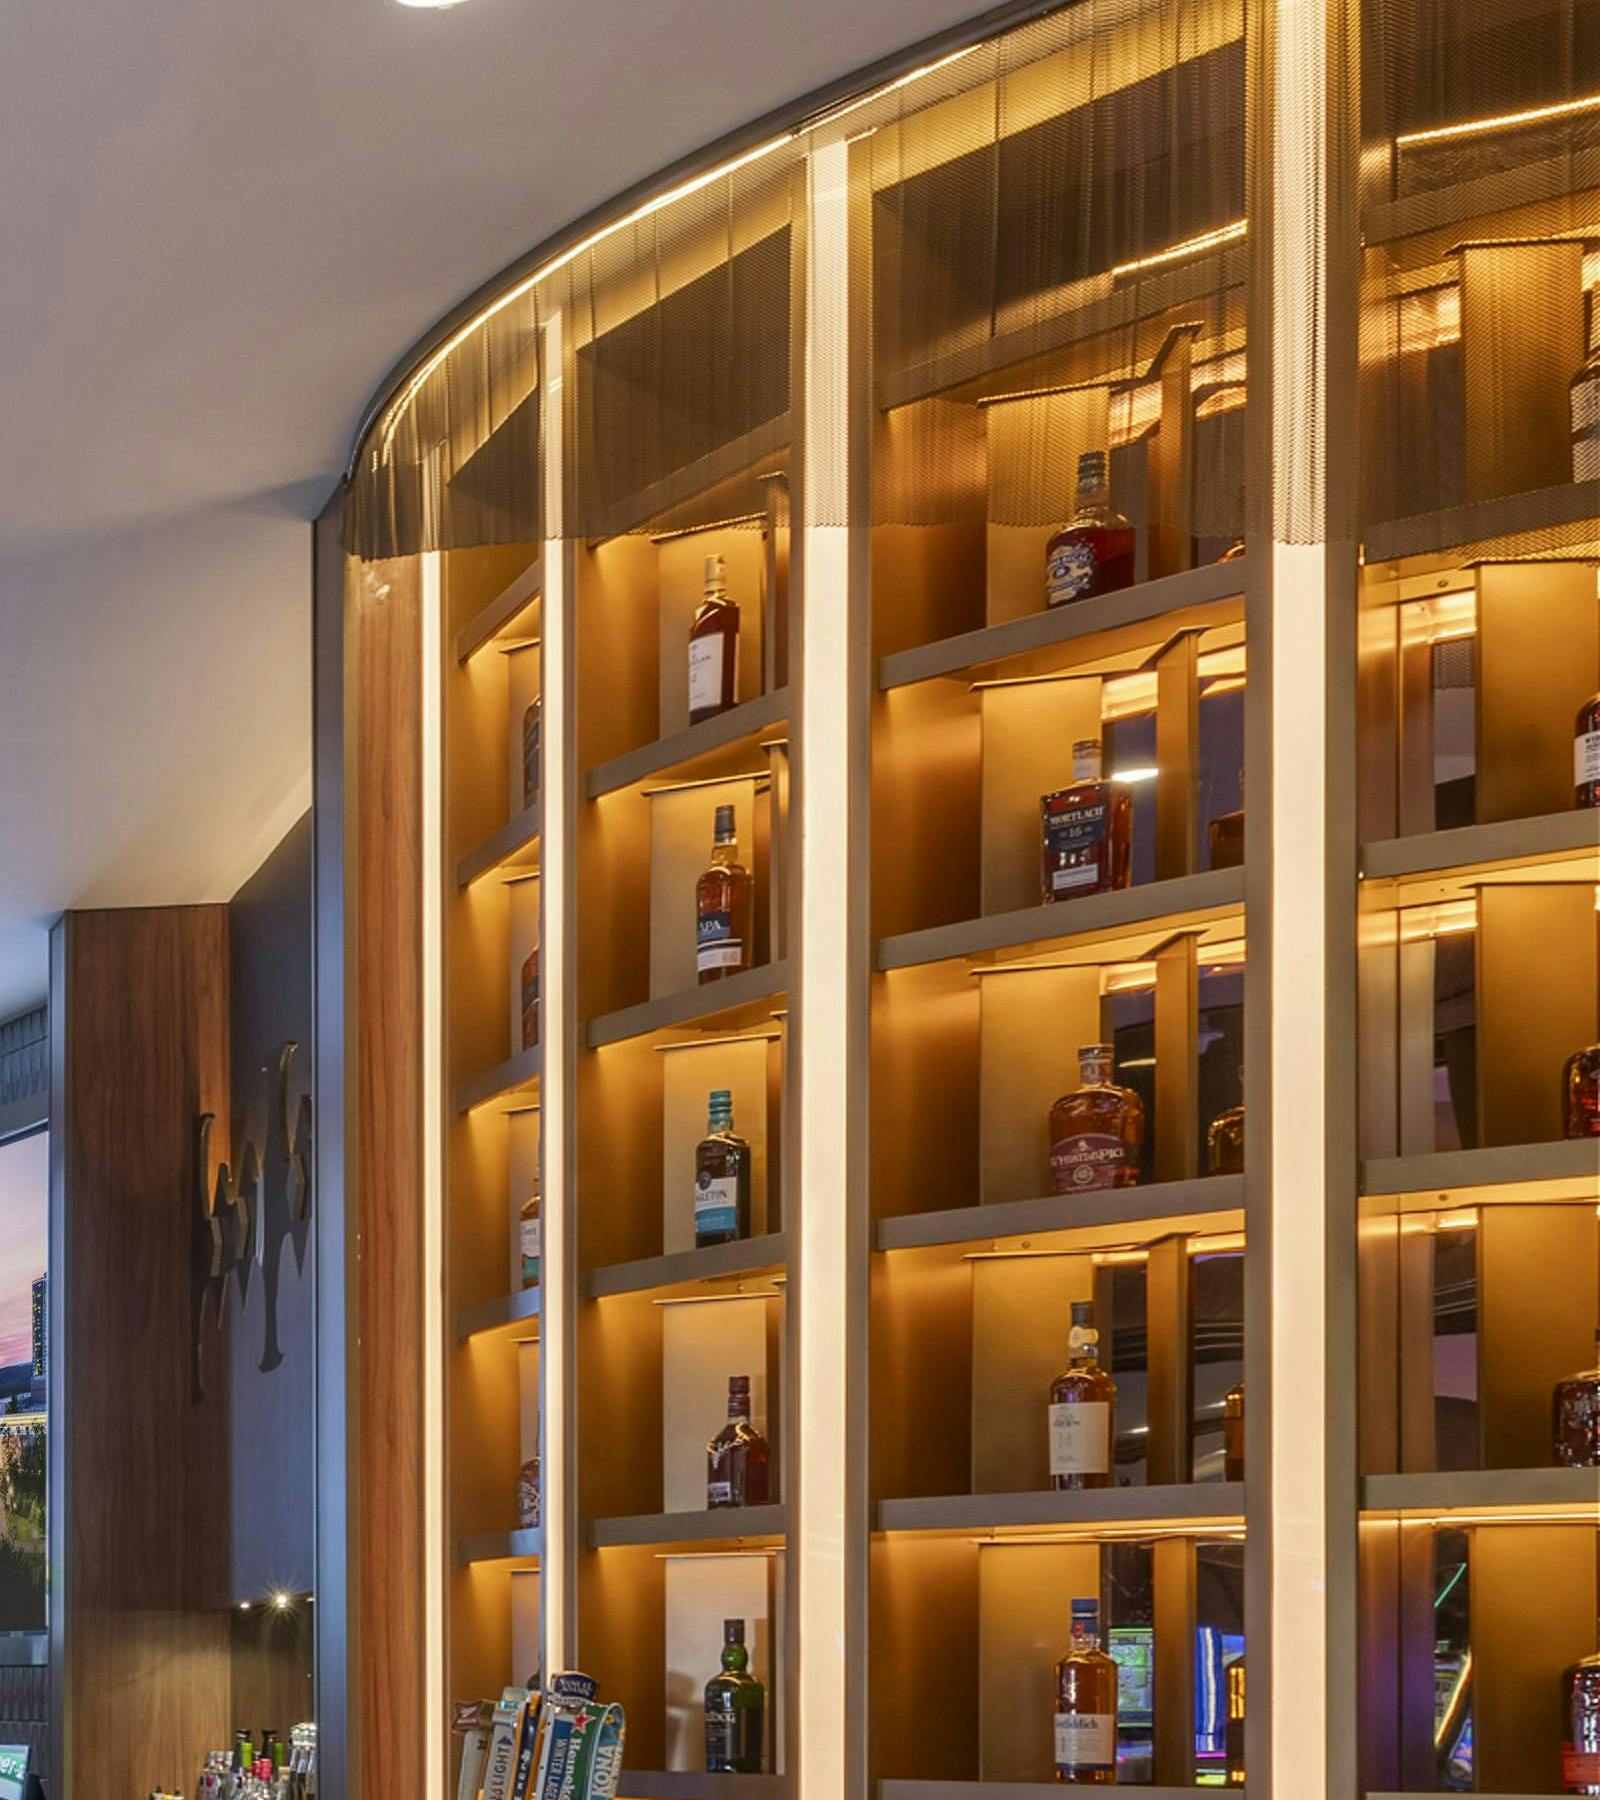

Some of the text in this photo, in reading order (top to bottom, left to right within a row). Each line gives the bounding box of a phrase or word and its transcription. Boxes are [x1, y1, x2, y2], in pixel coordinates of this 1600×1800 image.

[1049, 806, 1105, 824] MORTLACH
[492, 1748, 511, 1788] LIGHT
[592, 1746, 612, 1797] KONA
